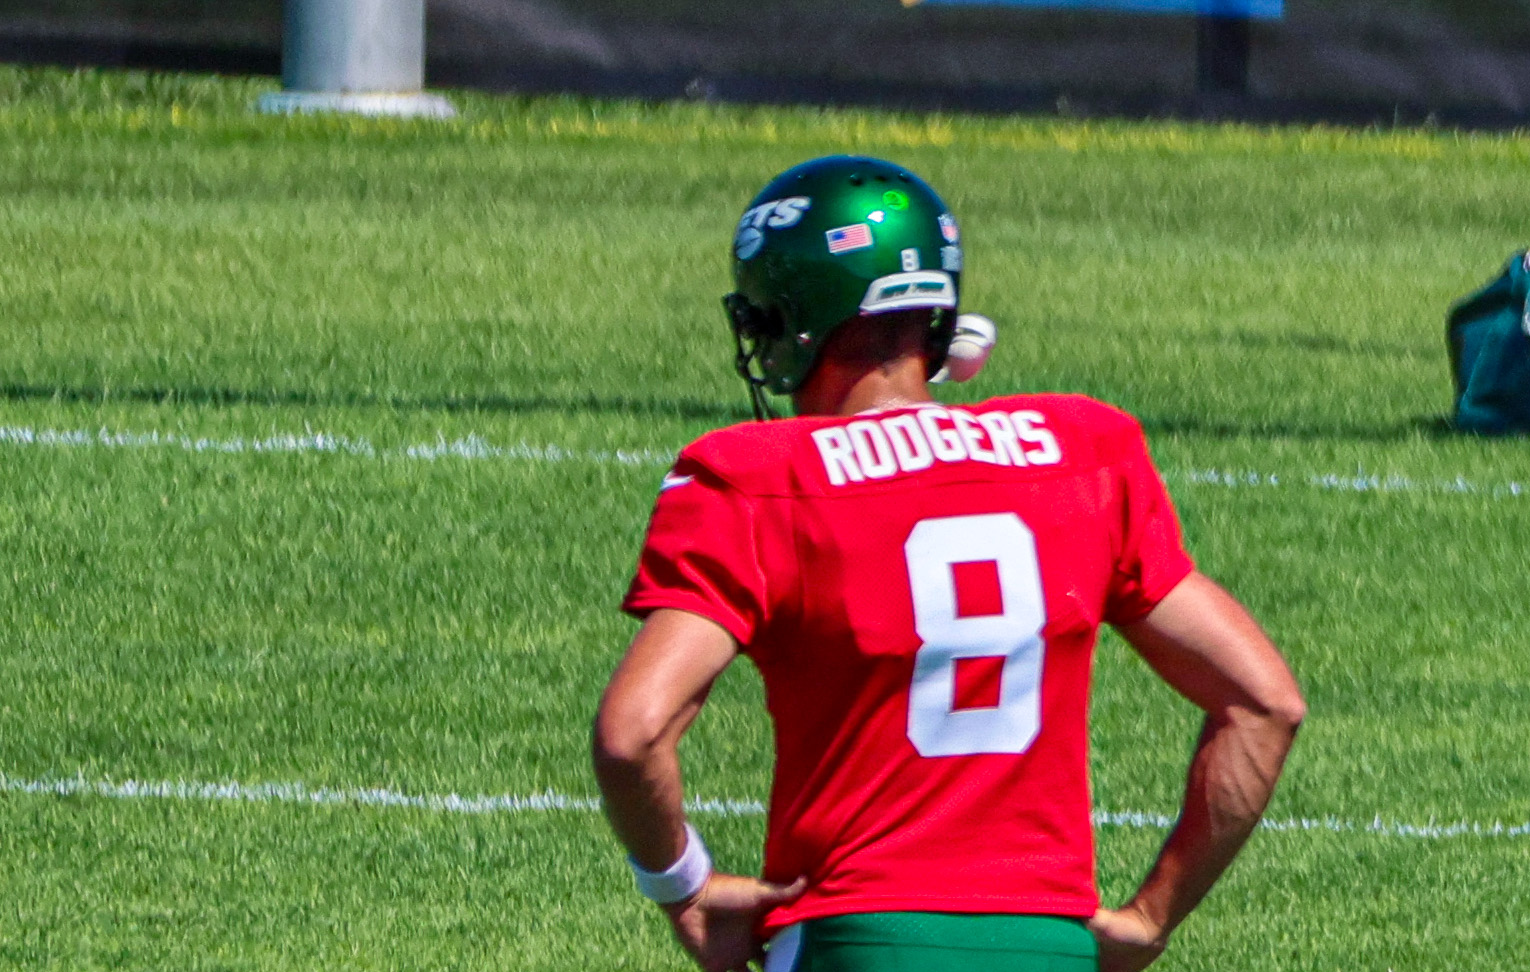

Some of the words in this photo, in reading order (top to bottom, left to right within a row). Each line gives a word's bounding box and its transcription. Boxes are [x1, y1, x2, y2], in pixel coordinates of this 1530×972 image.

[740, 196, 811, 229] ETS
[811, 407, 1062, 486] RODGERS
[904, 512, 1046, 758] 8
